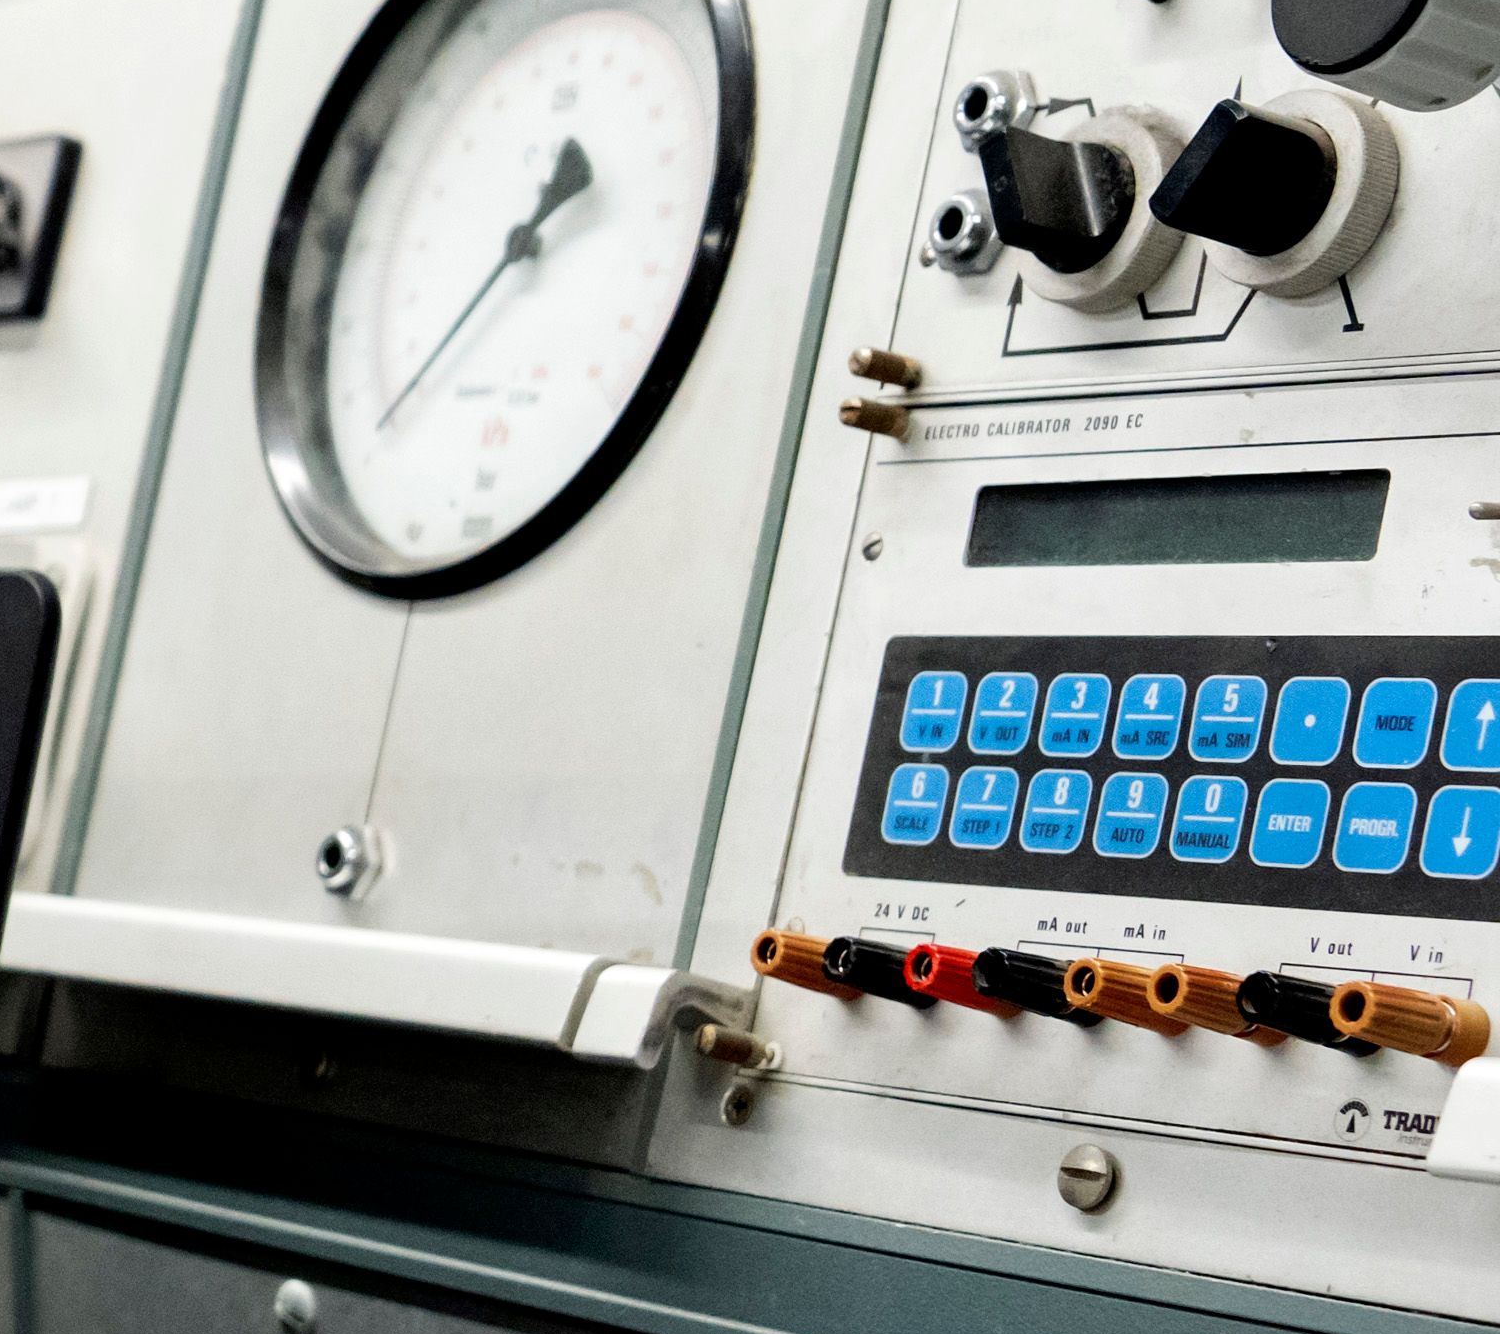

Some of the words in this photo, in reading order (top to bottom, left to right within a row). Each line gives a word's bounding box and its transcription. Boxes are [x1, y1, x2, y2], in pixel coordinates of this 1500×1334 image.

[924, 422, 980, 441] ELECTRO
[987, 418, 1071, 436] CALIBRATOR
[1083, 415, 1119, 432] 2090
[1126, 413, 1144, 429] EC
[933, 679, 944, 706] 1
[999, 680, 1016, 708] 2
[1070, 681, 1087, 709] 3
[1143, 682, 1160, 710] 4
[1222, 683, 1240, 713] 5
[918, 724, 927, 739] V
[930, 724, 944, 739] IN
[1374, 714, 1417, 732] MODE
[979, 726, 988, 740] V
[995, 727, 1019, 741] OUT
[1051, 728, 1071, 743] mA
[1076, 730, 1090, 744] IN
[1119, 731, 1140, 745] mA
[1145, 731, 1170, 746] SRC
[1197, 733, 1218, 748] mA
[1225, 733, 1251, 748] SIM
[911, 771, 927, 799] 6
[981, 773, 997, 801] 7
[1053, 776, 1070, 805] 8
[1126, 779, 1144, 809] 9
[1204, 782, 1222, 814] 0
[894, 816, 928, 831] SCALE
[962, 819, 990, 835] STEP
[1029, 822, 1060, 838] STEP
[1063, 824, 1075, 840] 2
[1267, 814, 1312, 832] ENTER
[1348, 817, 1399, 838] PROGR.
[1110, 827, 1145, 844] AUTO
[1175, 831, 1231, 849] MANUAL
[874, 902, 890, 918] 24
[897, 905, 905, 919] V
[912, 906, 930, 921] DC
[1037, 917, 1058, 933] mA
[1065, 920, 1088, 935] out
[1123, 924, 1145, 940] mA
[1152, 925, 1167, 941] in
[1310, 937, 1320, 954] V
[1328, 942, 1353, 957] out
[1410, 945, 1420, 962] V
[1429, 947, 1443, 964] in
[1383, 1110, 1440, 1135] TRAD
